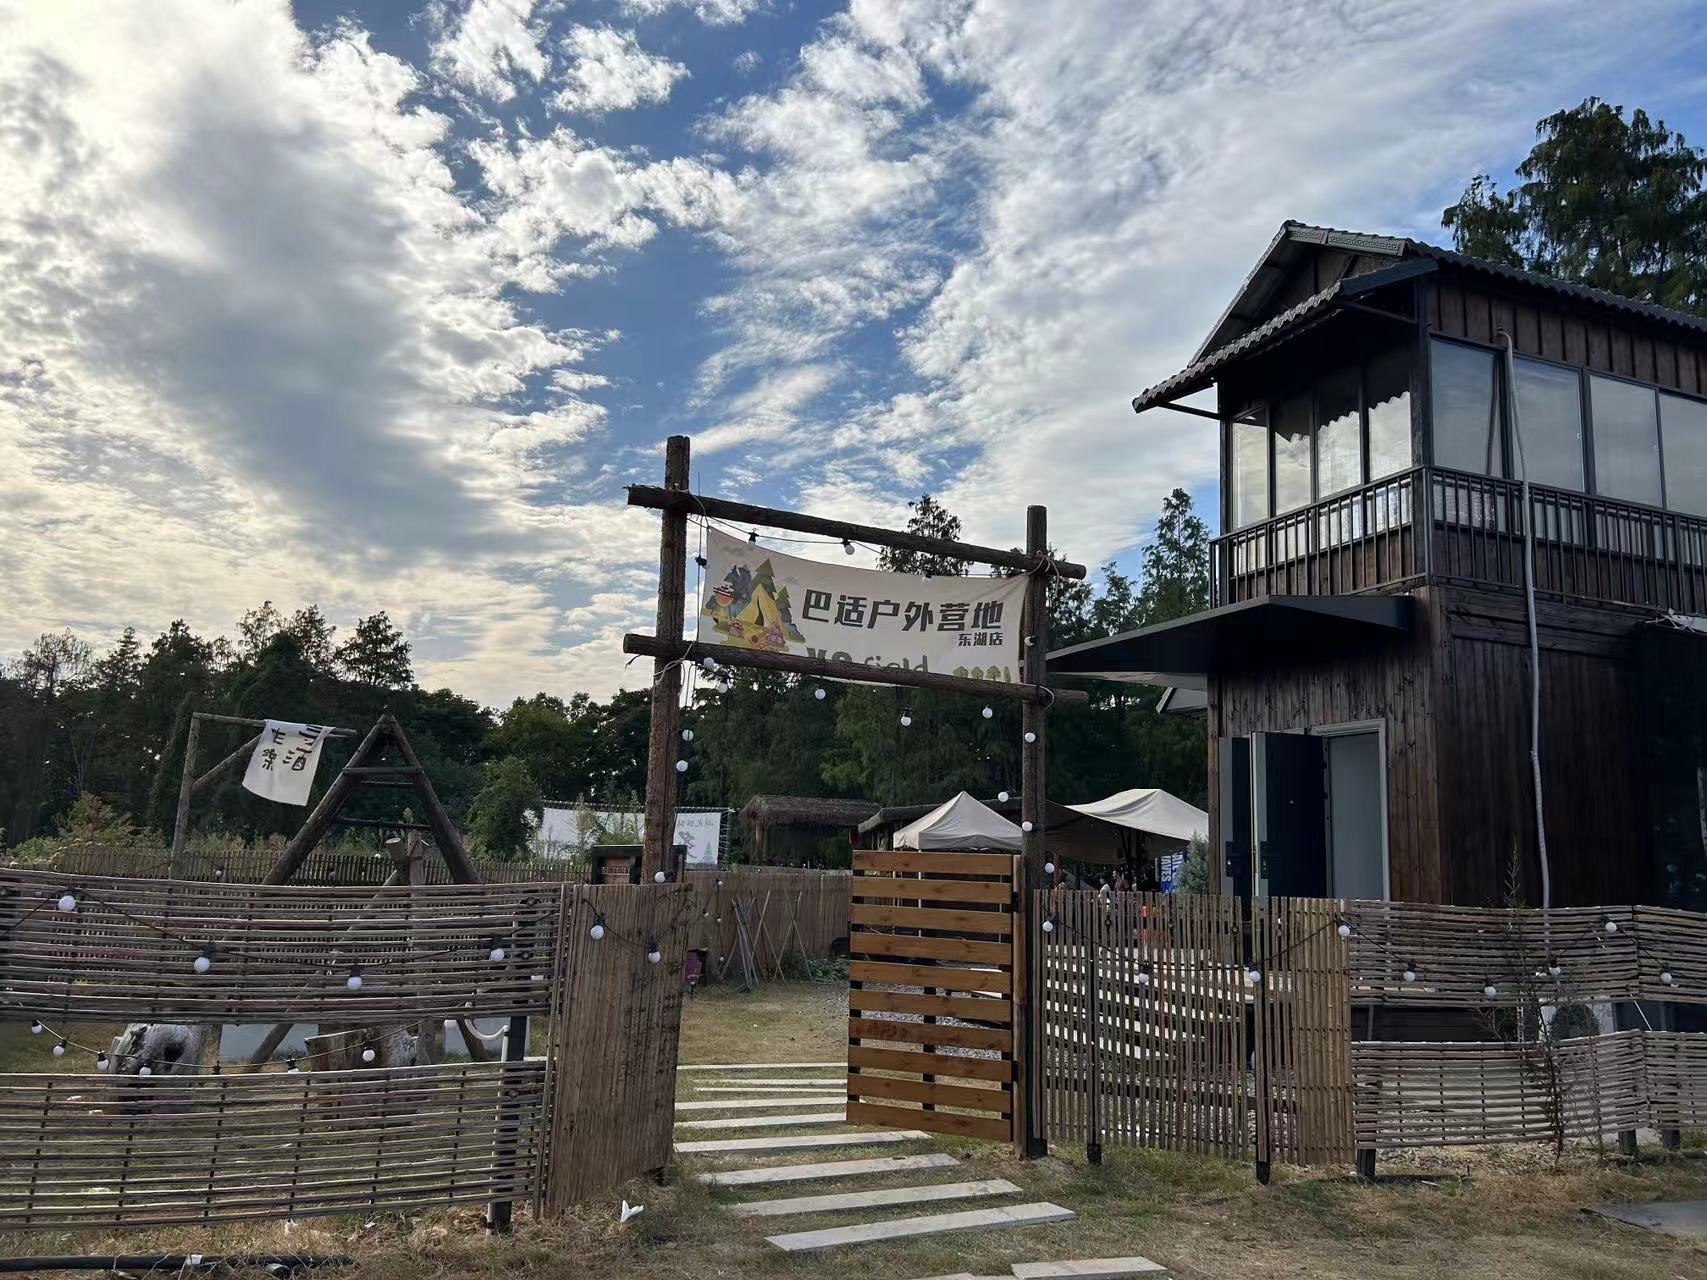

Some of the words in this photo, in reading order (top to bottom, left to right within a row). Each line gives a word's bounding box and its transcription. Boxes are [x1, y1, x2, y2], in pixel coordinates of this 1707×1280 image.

[801, 588, 1004, 632] 巴适户外营地
[958, 631, 1003, 647] 东湖店
